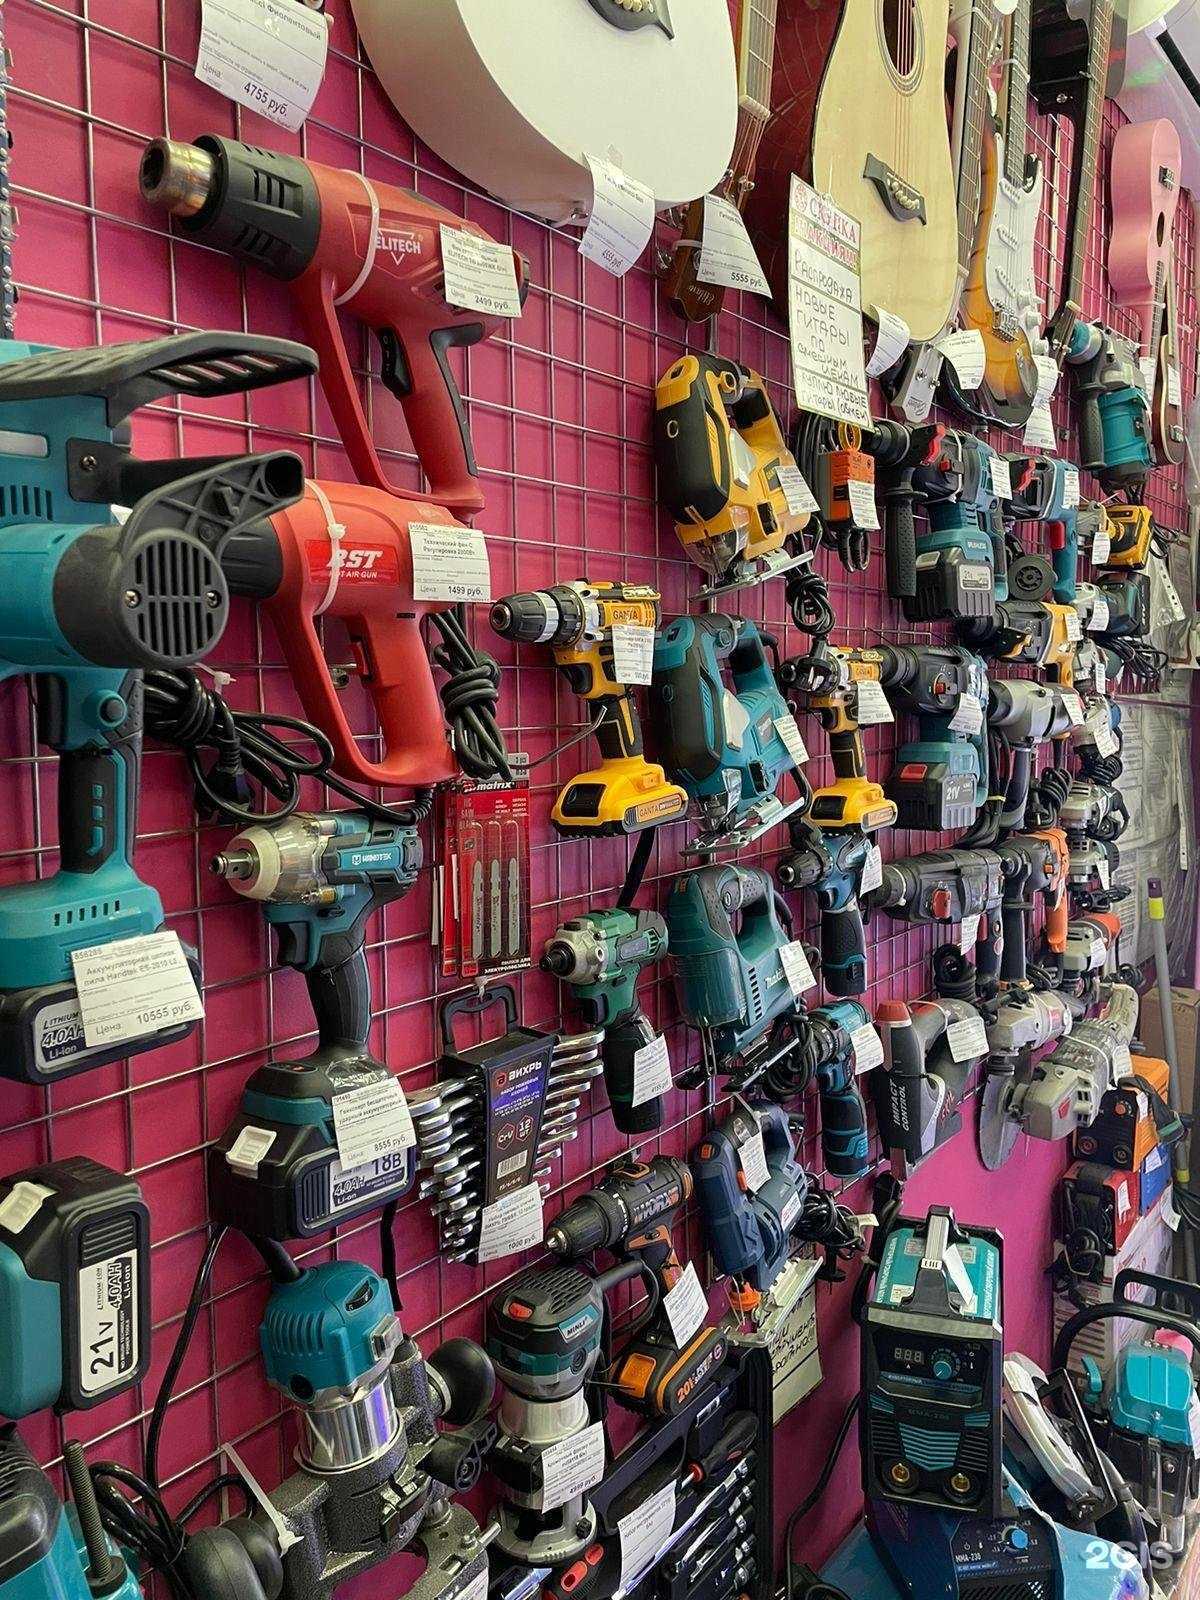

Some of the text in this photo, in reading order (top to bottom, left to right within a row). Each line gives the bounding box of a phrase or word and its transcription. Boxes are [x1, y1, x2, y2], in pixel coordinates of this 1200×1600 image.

[244, 82, 268, 104] 4755
[376, 236, 421, 255] ELITECH
[730, 272, 749, 284] 5555
[361, 571, 377, 579] GUN
[448, 585, 466, 595] 1499
[95, 1022, 122, 1036] Цена
[136, 1009, 170, 1025] 10555
[508, 1061, 542, 1081] ВИХРЬ
[889, 1078, 900, 1127] IMPACT
[519, 1119, 531, 1132] 12
[374, 1139, 392, 1152] 8555
